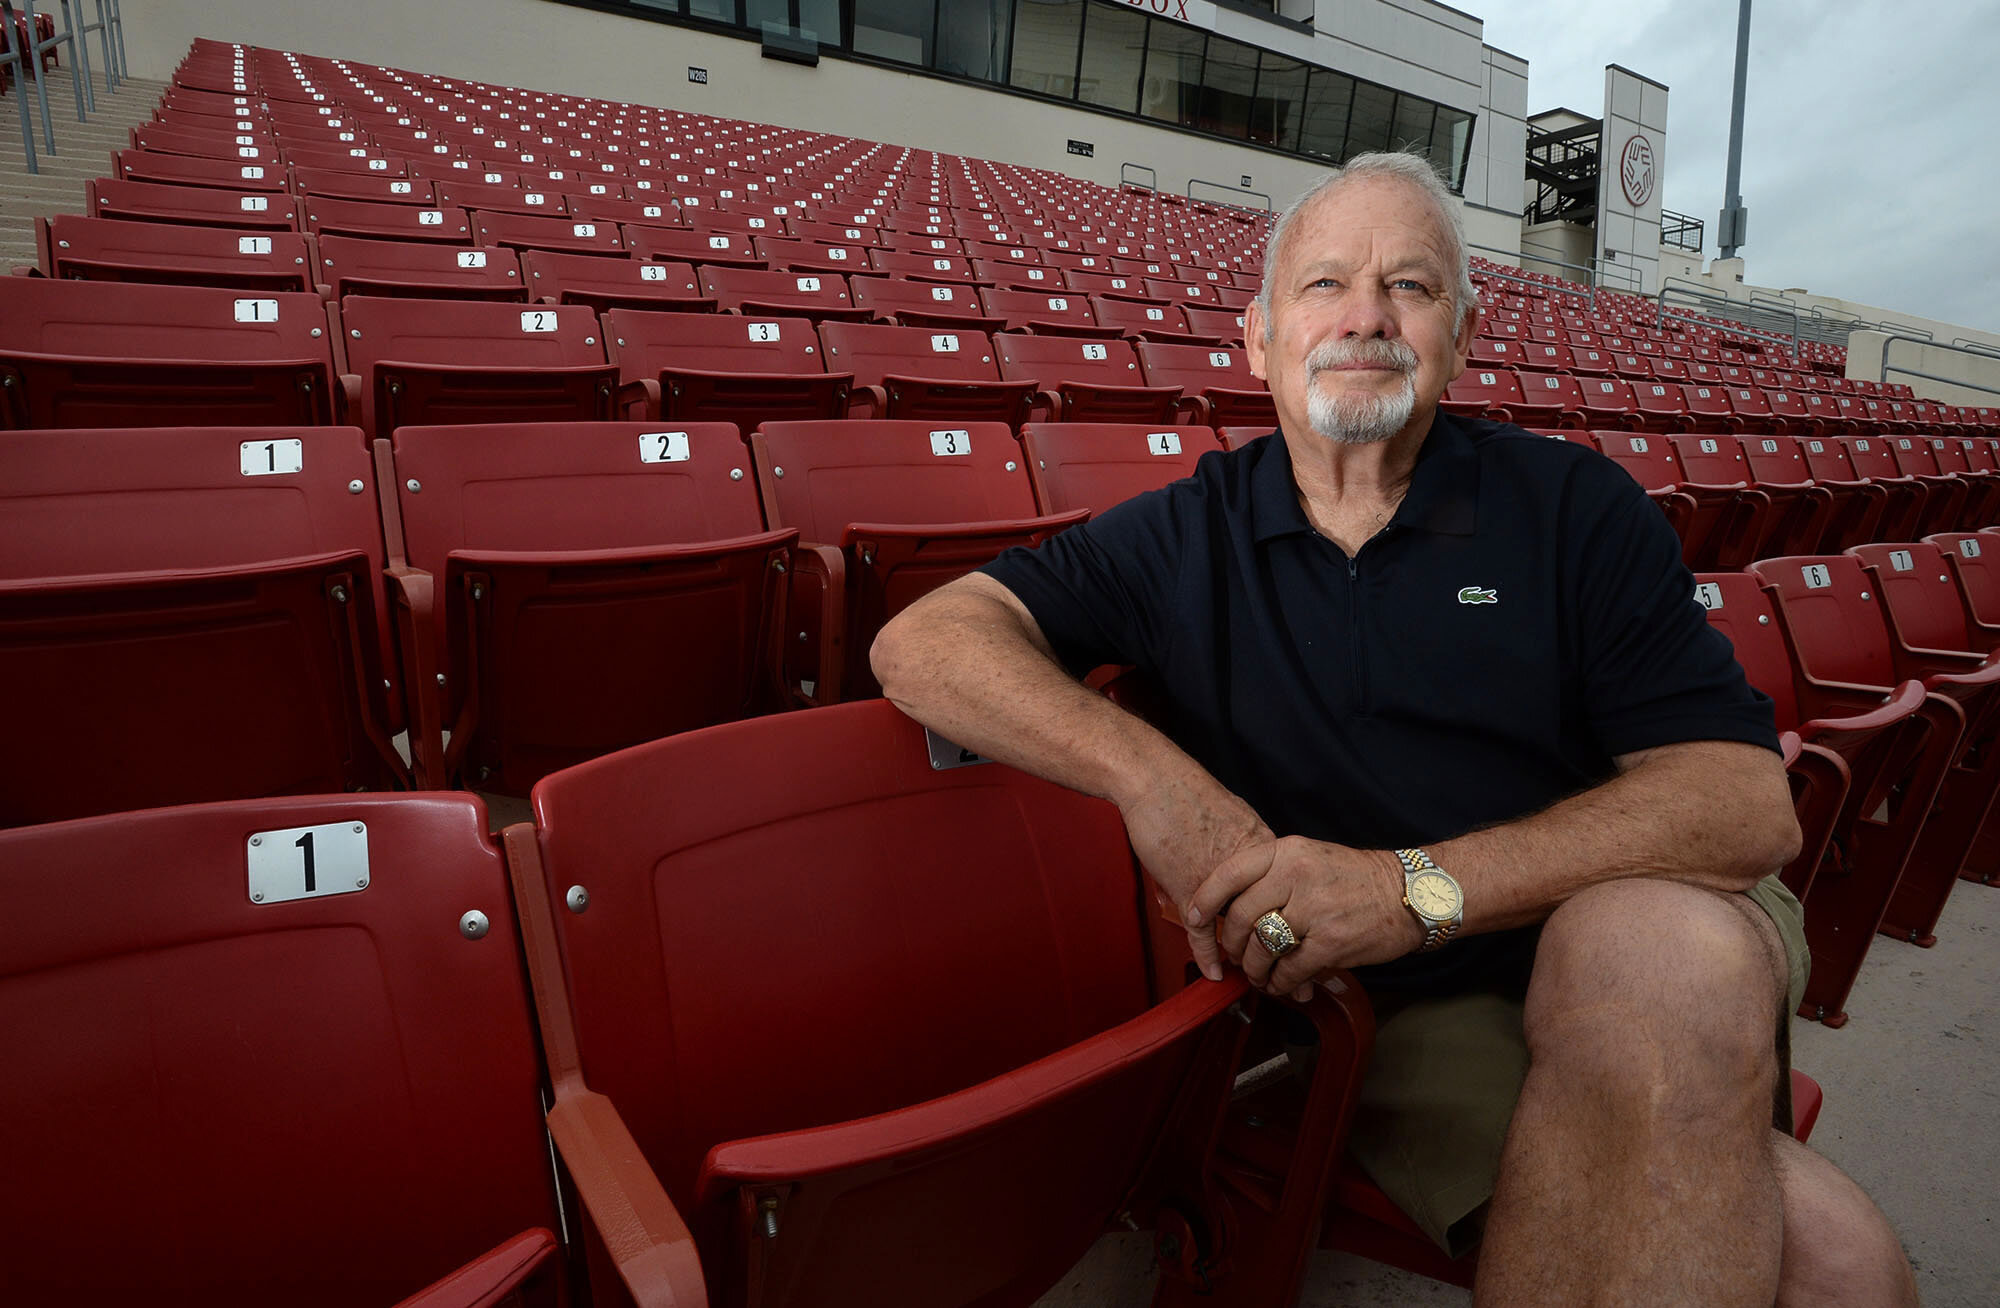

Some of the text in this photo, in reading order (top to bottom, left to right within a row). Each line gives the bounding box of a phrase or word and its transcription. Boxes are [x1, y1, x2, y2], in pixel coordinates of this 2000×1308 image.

[1128, 0, 1189, 21] OX
[247, 148, 250, 157] 1
[376, 161, 381, 169] 2
[250, 168, 254, 178] 1
[398, 183, 404, 192] 2
[252, 199, 256, 210] 1
[532, 195, 538, 204] 3
[427, 212, 434, 224] 2
[754, 219, 760, 227] 5
[582, 226, 588, 237] 3
[252, 239, 257, 252] 1
[716, 238, 722, 247] 4
[468, 253, 476, 266] 2
[835, 250, 841, 259] 5
[939, 261, 945, 270] 6
[650, 267, 657, 280] 3
[1033, 271, 1038, 279] 7
[806, 279, 812, 290] 4
[939, 289, 946, 300] 5
[1055, 300, 1062, 310] 6
[251, 302, 259, 320] 1
[1152, 310, 1157, 319] 7
[534, 313, 544, 330] 2
[760, 325, 768, 340] 3
[942, 337, 950, 350] 4
[1091, 346, 1098, 359] 5
[1216, 353, 1224, 366] 6
[1485, 374, 1491, 384] 9
[1548, 378, 1557, 388] 10
[1603, 384, 1611, 392] 11
[1654, 387, 1663, 395] 12
[1700, 389, 1708, 398] 13
[658, 435, 671, 460] 2
[945, 433, 956, 454] 3
[1161, 435, 1170, 453] 4
[1636, 439, 1643, 452] 8
[1706, 440, 1713, 452] 9
[1764, 441, 1775, 452] 10
[1812, 442, 1821, 452] 11
[1858, 441, 1867, 450] 12
[1901, 440, 1909, 449] 13
[265, 443, 275, 472] 1
[1966, 541, 1974, 556] 8
[1897, 553, 1905, 570] 7
[1811, 567, 1821, 586] 6
[1700, 586, 1712, 608] 5
[295, 832, 316, 892] 1
